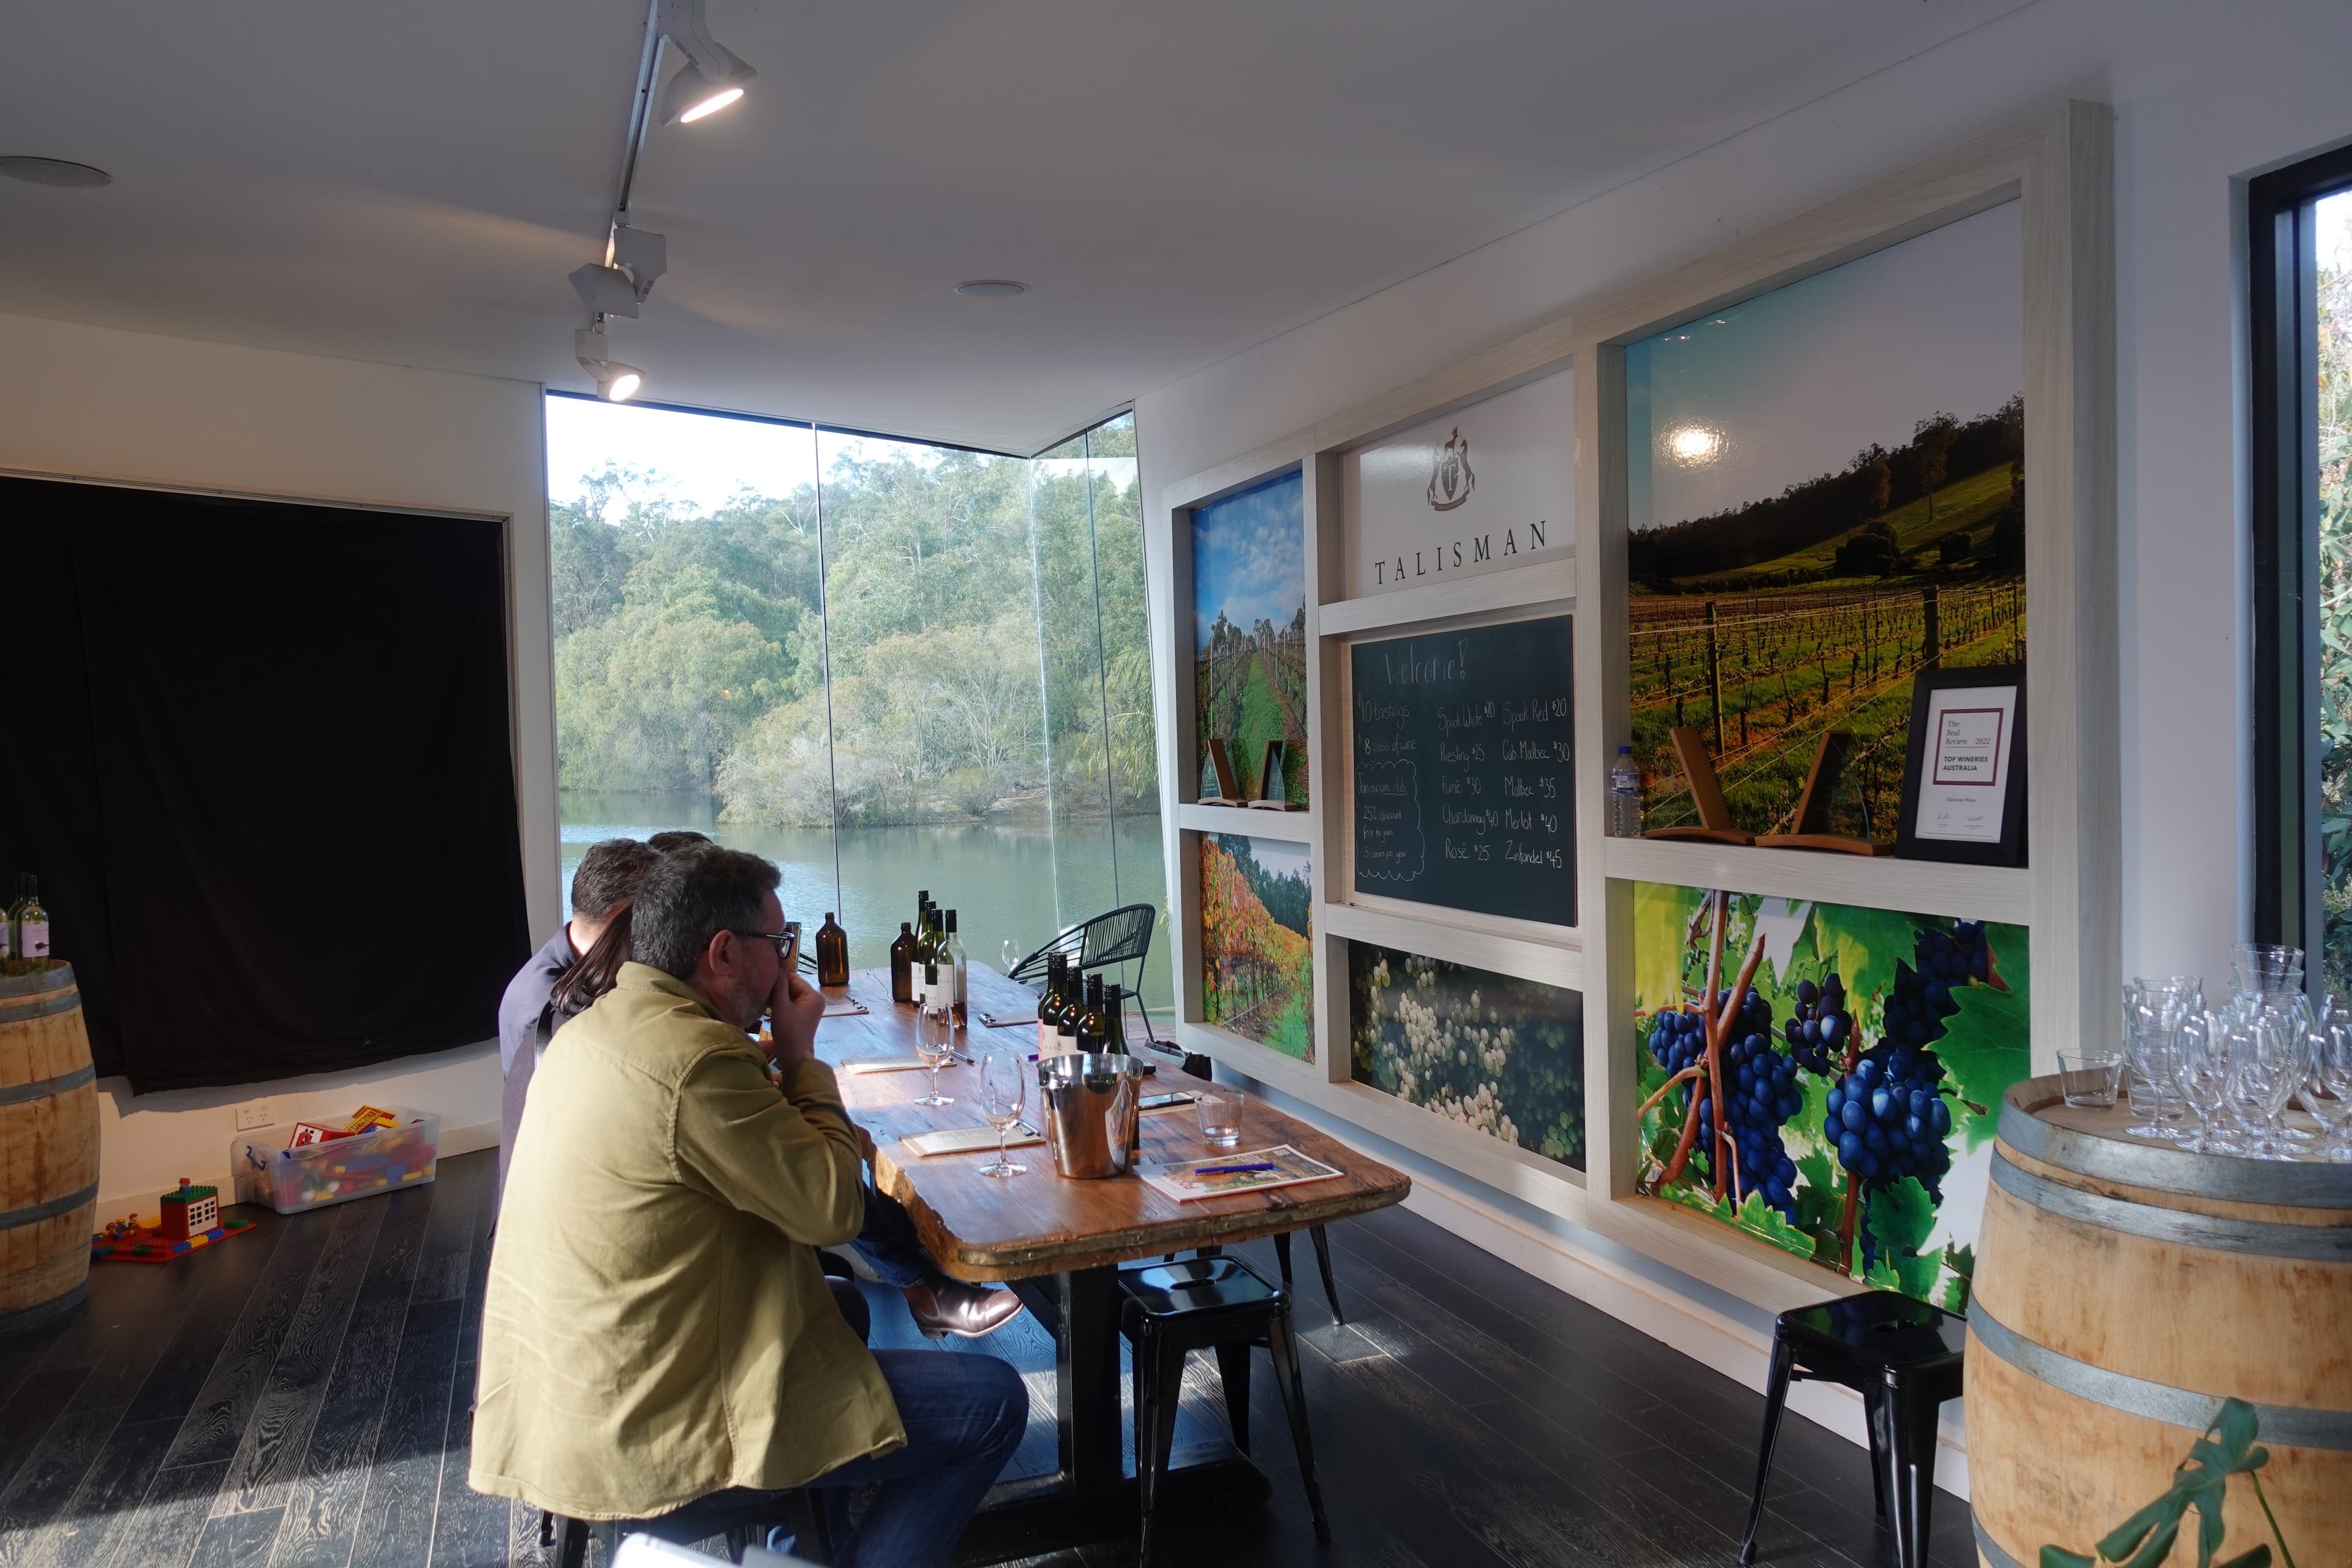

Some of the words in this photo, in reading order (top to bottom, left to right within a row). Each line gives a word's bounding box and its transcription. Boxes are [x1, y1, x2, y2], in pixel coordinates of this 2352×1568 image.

[1374, 520, 1546, 584] TALISMAN
[1385, 639, 1468, 684] Welcome!
[1374, 700, 1410, 729] tastings
[1438, 706, 1461, 737] Spook
[1463, 704, 1483, 728] White
[1484, 701, 1495, 718] $20
[1502, 701, 1528, 731] Spook
[1532, 699, 1549, 722] Red
[1551, 698, 1567, 717] $20
[1392, 733, 1399, 755] of
[1400, 740, 1417, 750] wine
[1502, 739, 1517, 760] Cab
[1520, 739, 1550, 761] Malbec
[1553, 741, 1570, 763] $30
[1440, 742, 1469, 772] Riesling
[1472, 743, 1485, 761] $25
[1357, 772, 1369, 794] Join
[1393, 775, 1407, 793] club
[1442, 775, 1461, 793] Fumé
[1466, 776, 1481, 794] $30
[1504, 775, 1534, 796] Malbec
[1539, 777, 1556, 798] $35
[1363, 805, 1377, 821] 25%
[1379, 808, 1401, 821] discount
[1442, 802, 1485, 835] Chardonnay
[1486, 808, 1499, 827] $40
[1506, 808, 1532, 829] Merlot
[1540, 813, 1557, 832] $40
[1381, 830, 1393, 843] join
[1364, 845, 1370, 858] 3
[1371, 849, 1385, 858] cases
[1446, 838, 1469, 859] Rosé
[1474, 845, 1490, 861] $25
[1505, 840, 1543, 865] Zinfandel
[1546, 849, 1562, 869] $45
